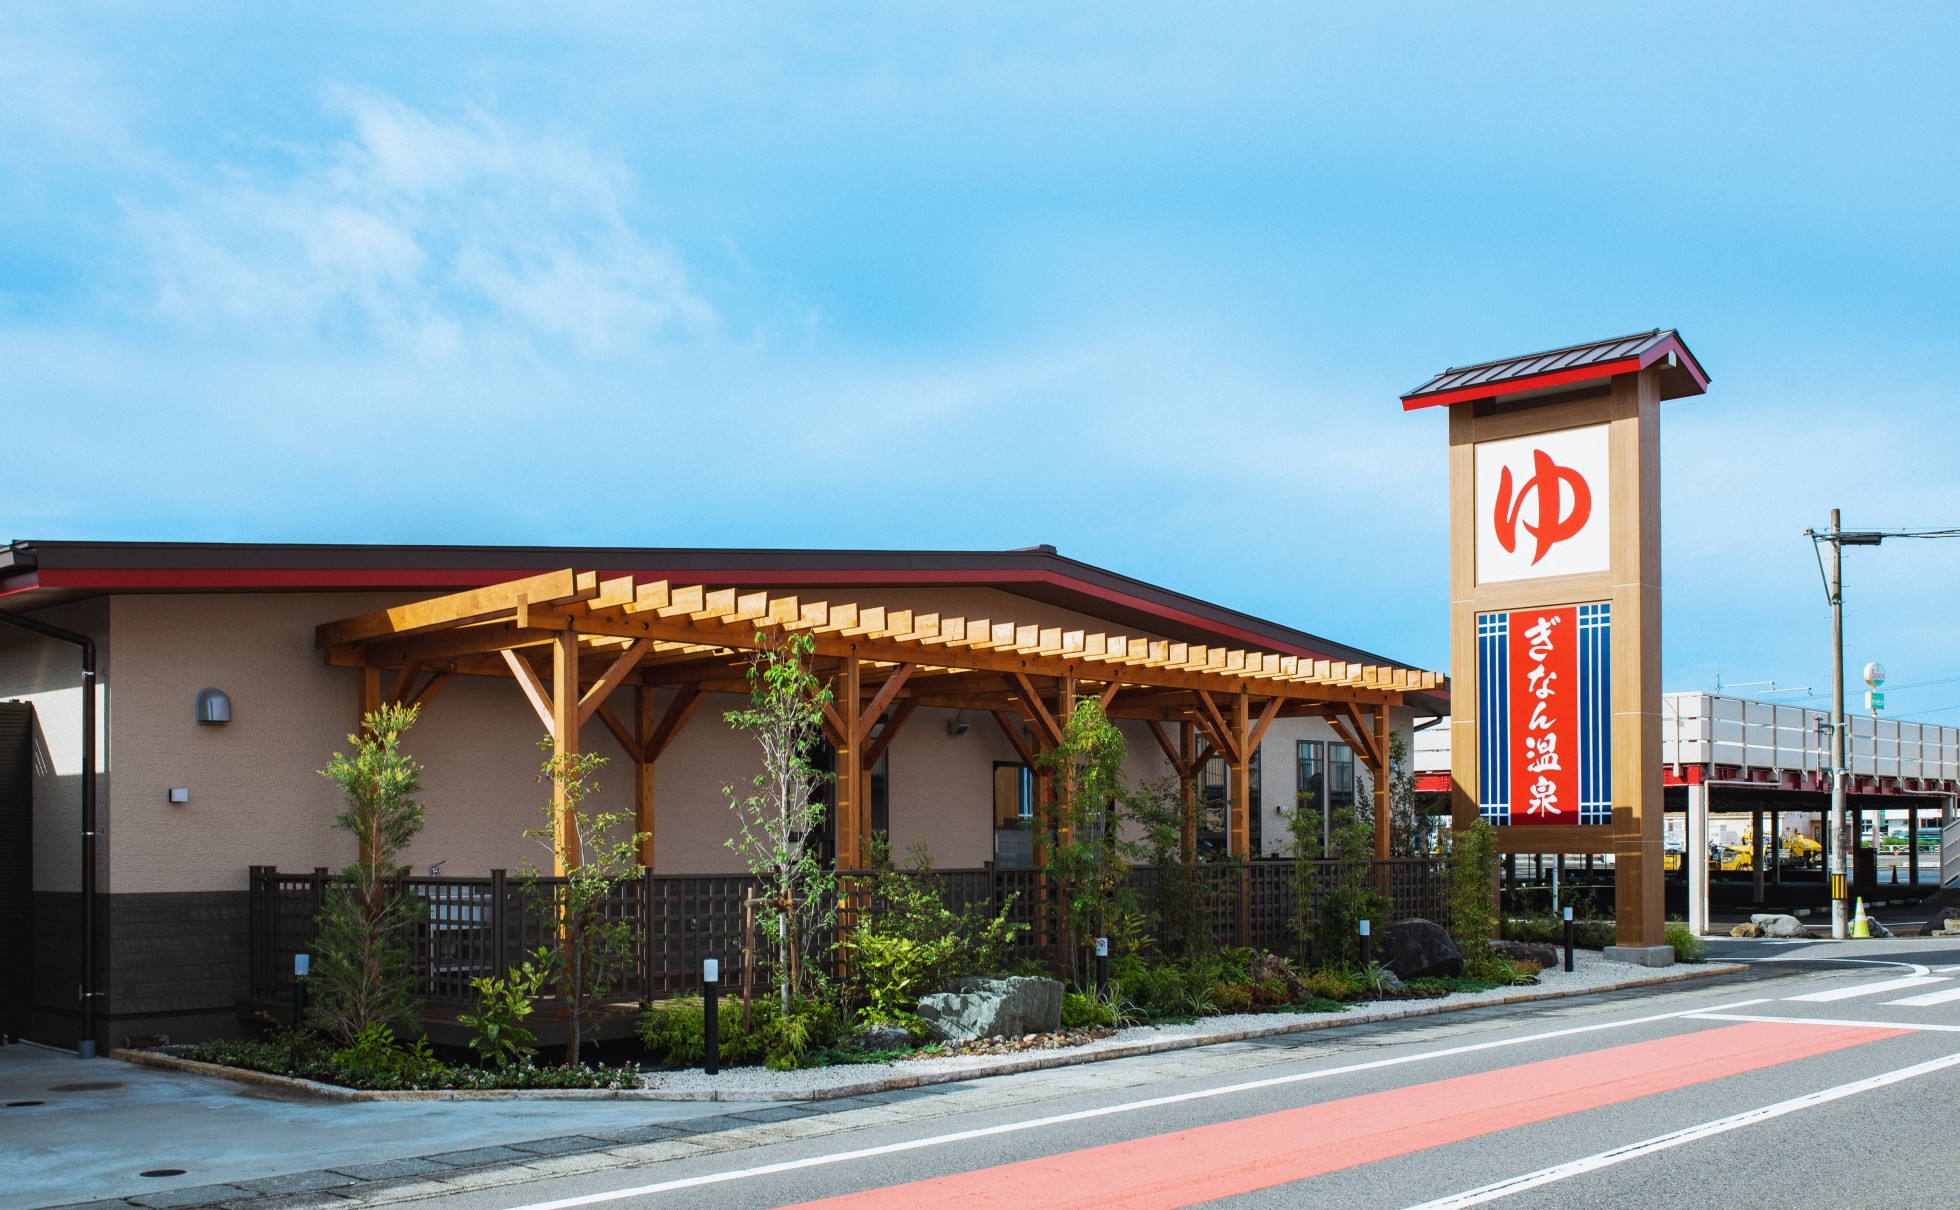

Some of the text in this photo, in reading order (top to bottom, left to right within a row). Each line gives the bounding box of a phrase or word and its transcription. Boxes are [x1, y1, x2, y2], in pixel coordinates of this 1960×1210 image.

[1494, 449, 1591, 566] ゆ
[1524, 615, 1562, 818] ぎなん温泉
